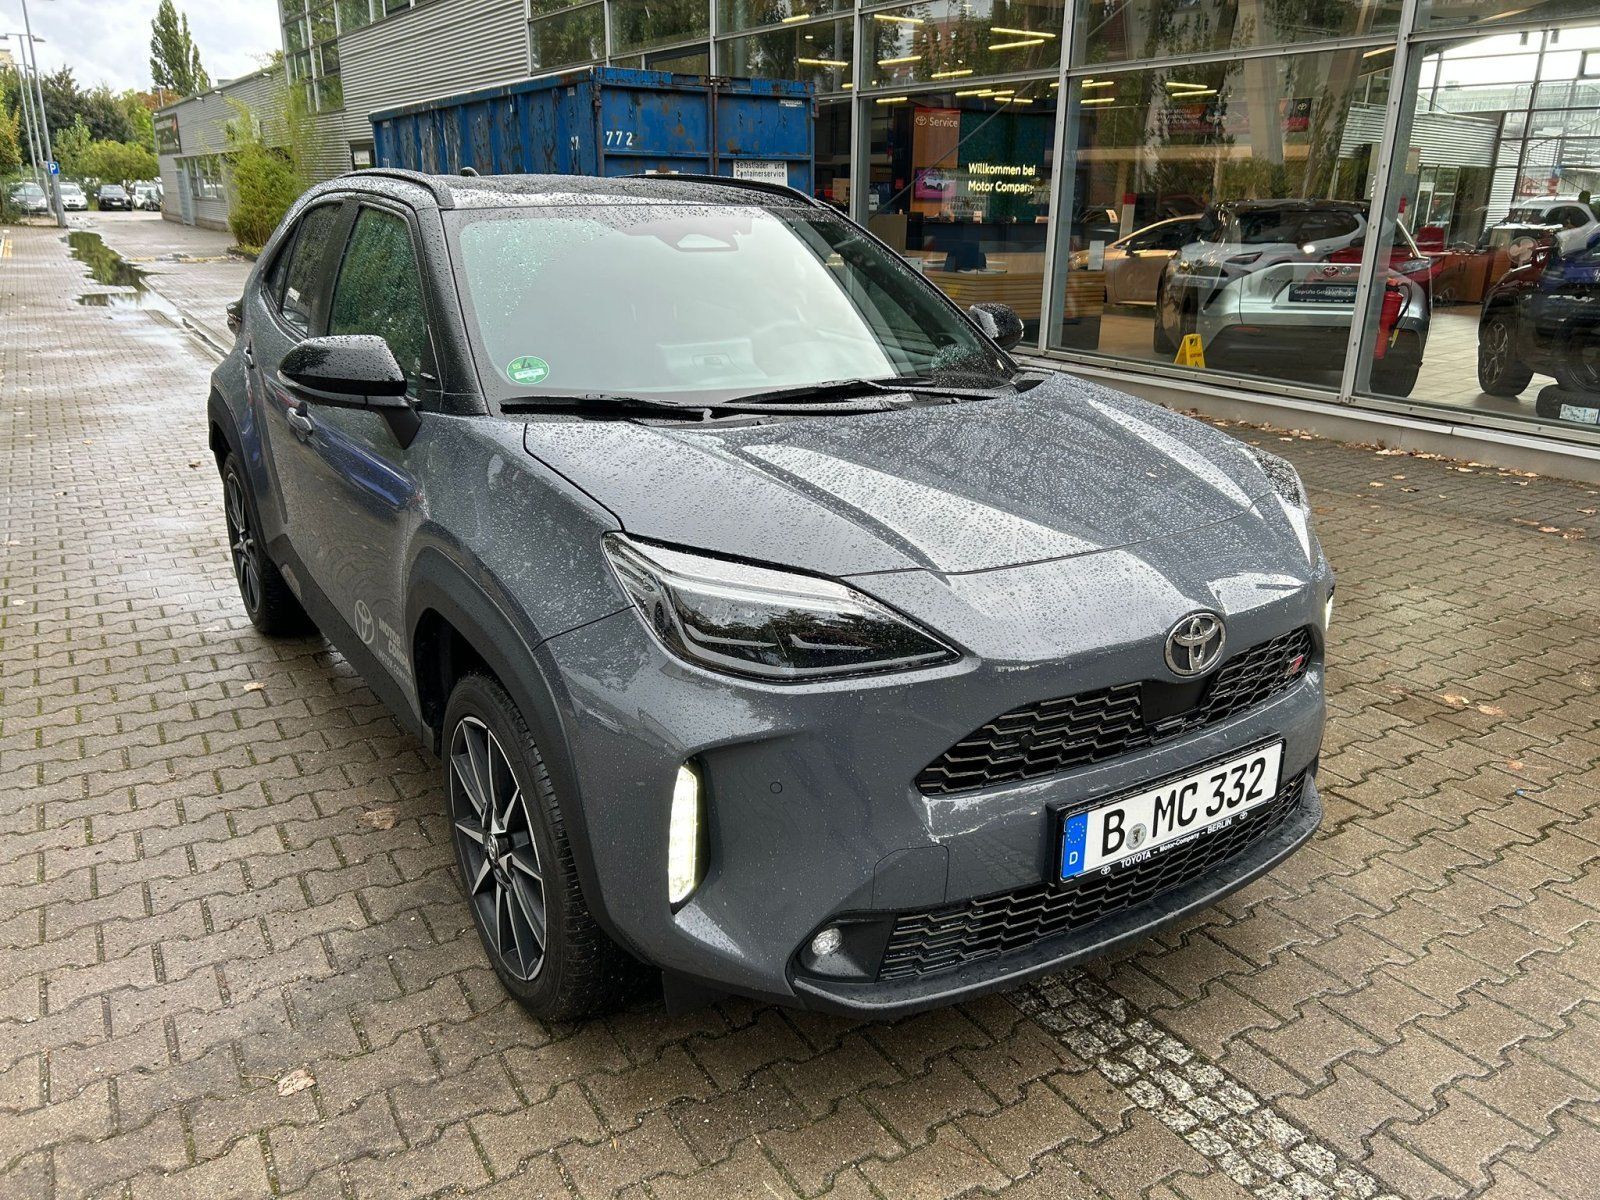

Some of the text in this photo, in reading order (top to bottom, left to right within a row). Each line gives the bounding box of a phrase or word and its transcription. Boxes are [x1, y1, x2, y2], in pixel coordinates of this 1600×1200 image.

[929, 118, 958, 128] Service
[606, 130, 633, 146] 772
[774, 161, 785, 169] und
[968, 163, 1036, 176] Willkommen bei
[735, 169, 785, 178] Containerservice
[968, 181, 1035, 194] Motor Company
[521, 358, 533, 369] 4
[378, 617, 401, 649] MOTOR
[1068, 851, 1079, 866] D
[1101, 808, 1126, 857] B
[1152, 782, 1198, 838] MC
[1205, 757, 1266, 817] 332
[1120, 850, 1152, 869] TOYOTA
[1159, 833, 1200, 853] Motor-Company
[1207, 818, 1233, 835] BERLIN
